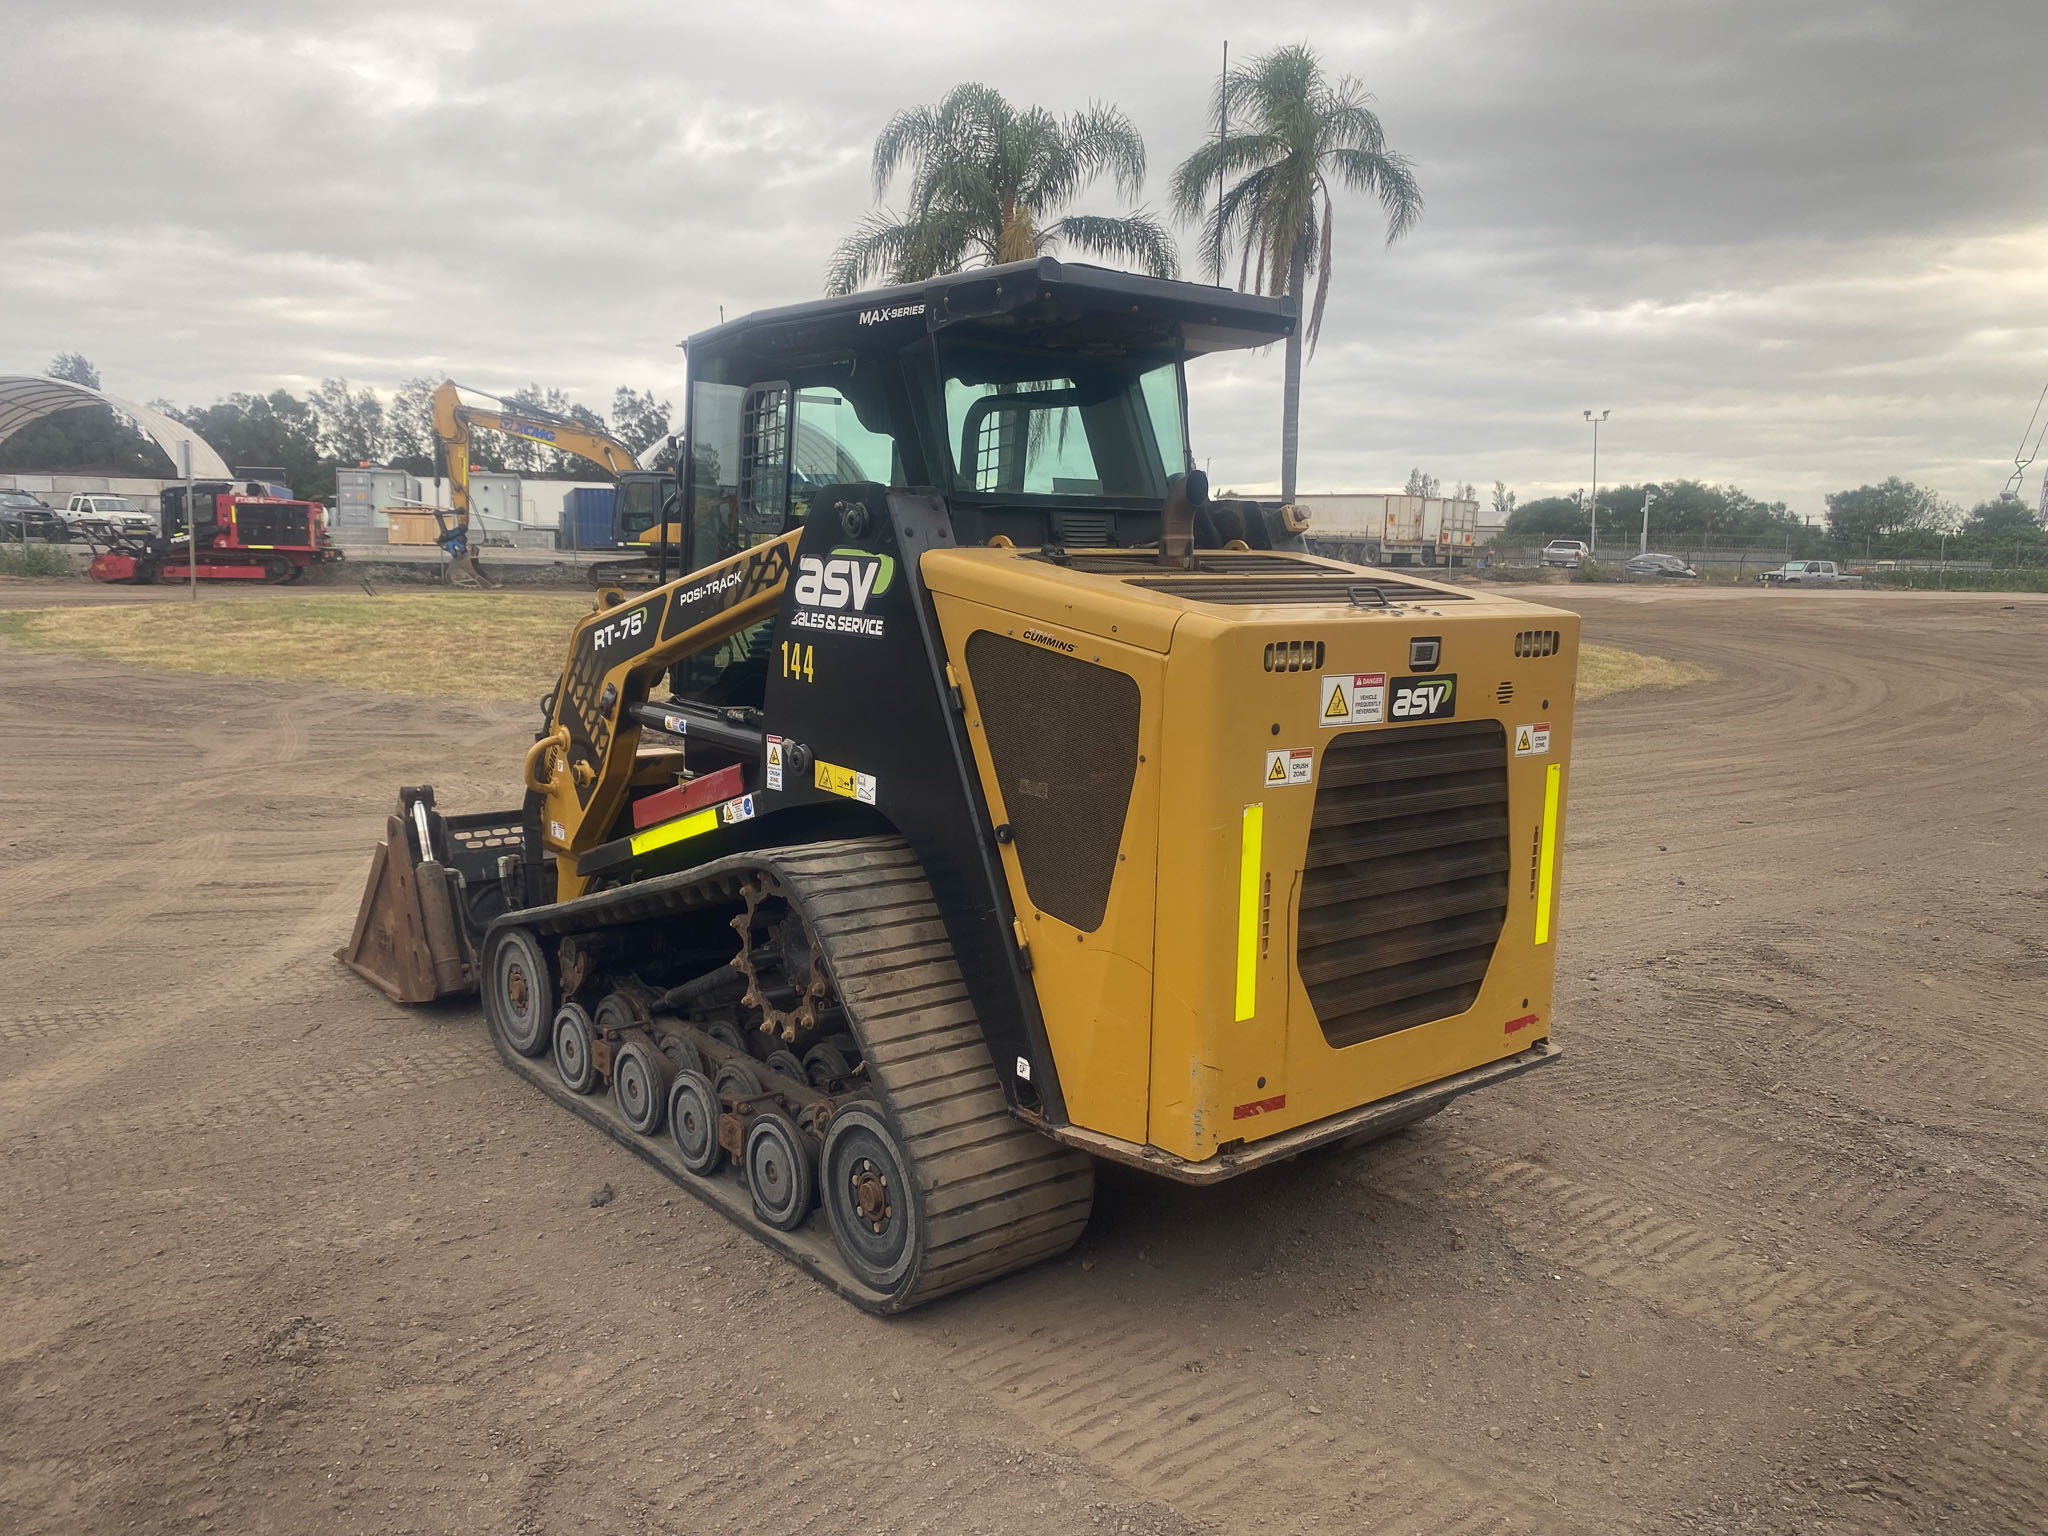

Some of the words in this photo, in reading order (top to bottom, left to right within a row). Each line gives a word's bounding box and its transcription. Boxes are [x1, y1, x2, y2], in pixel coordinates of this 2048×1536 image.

[859, 304, 926, 326] MAX-SERIES
[680, 571, 741, 606] POSI-TRACK
[594, 613, 642, 650] RT-75
[825, 614, 837, 630] &
[837, 615, 884, 636] SERVICE
[1023, 630, 1075, 653] CUMMINS
[781, 640, 814, 683] 144
[1363, 677, 1383, 685] DANGER
